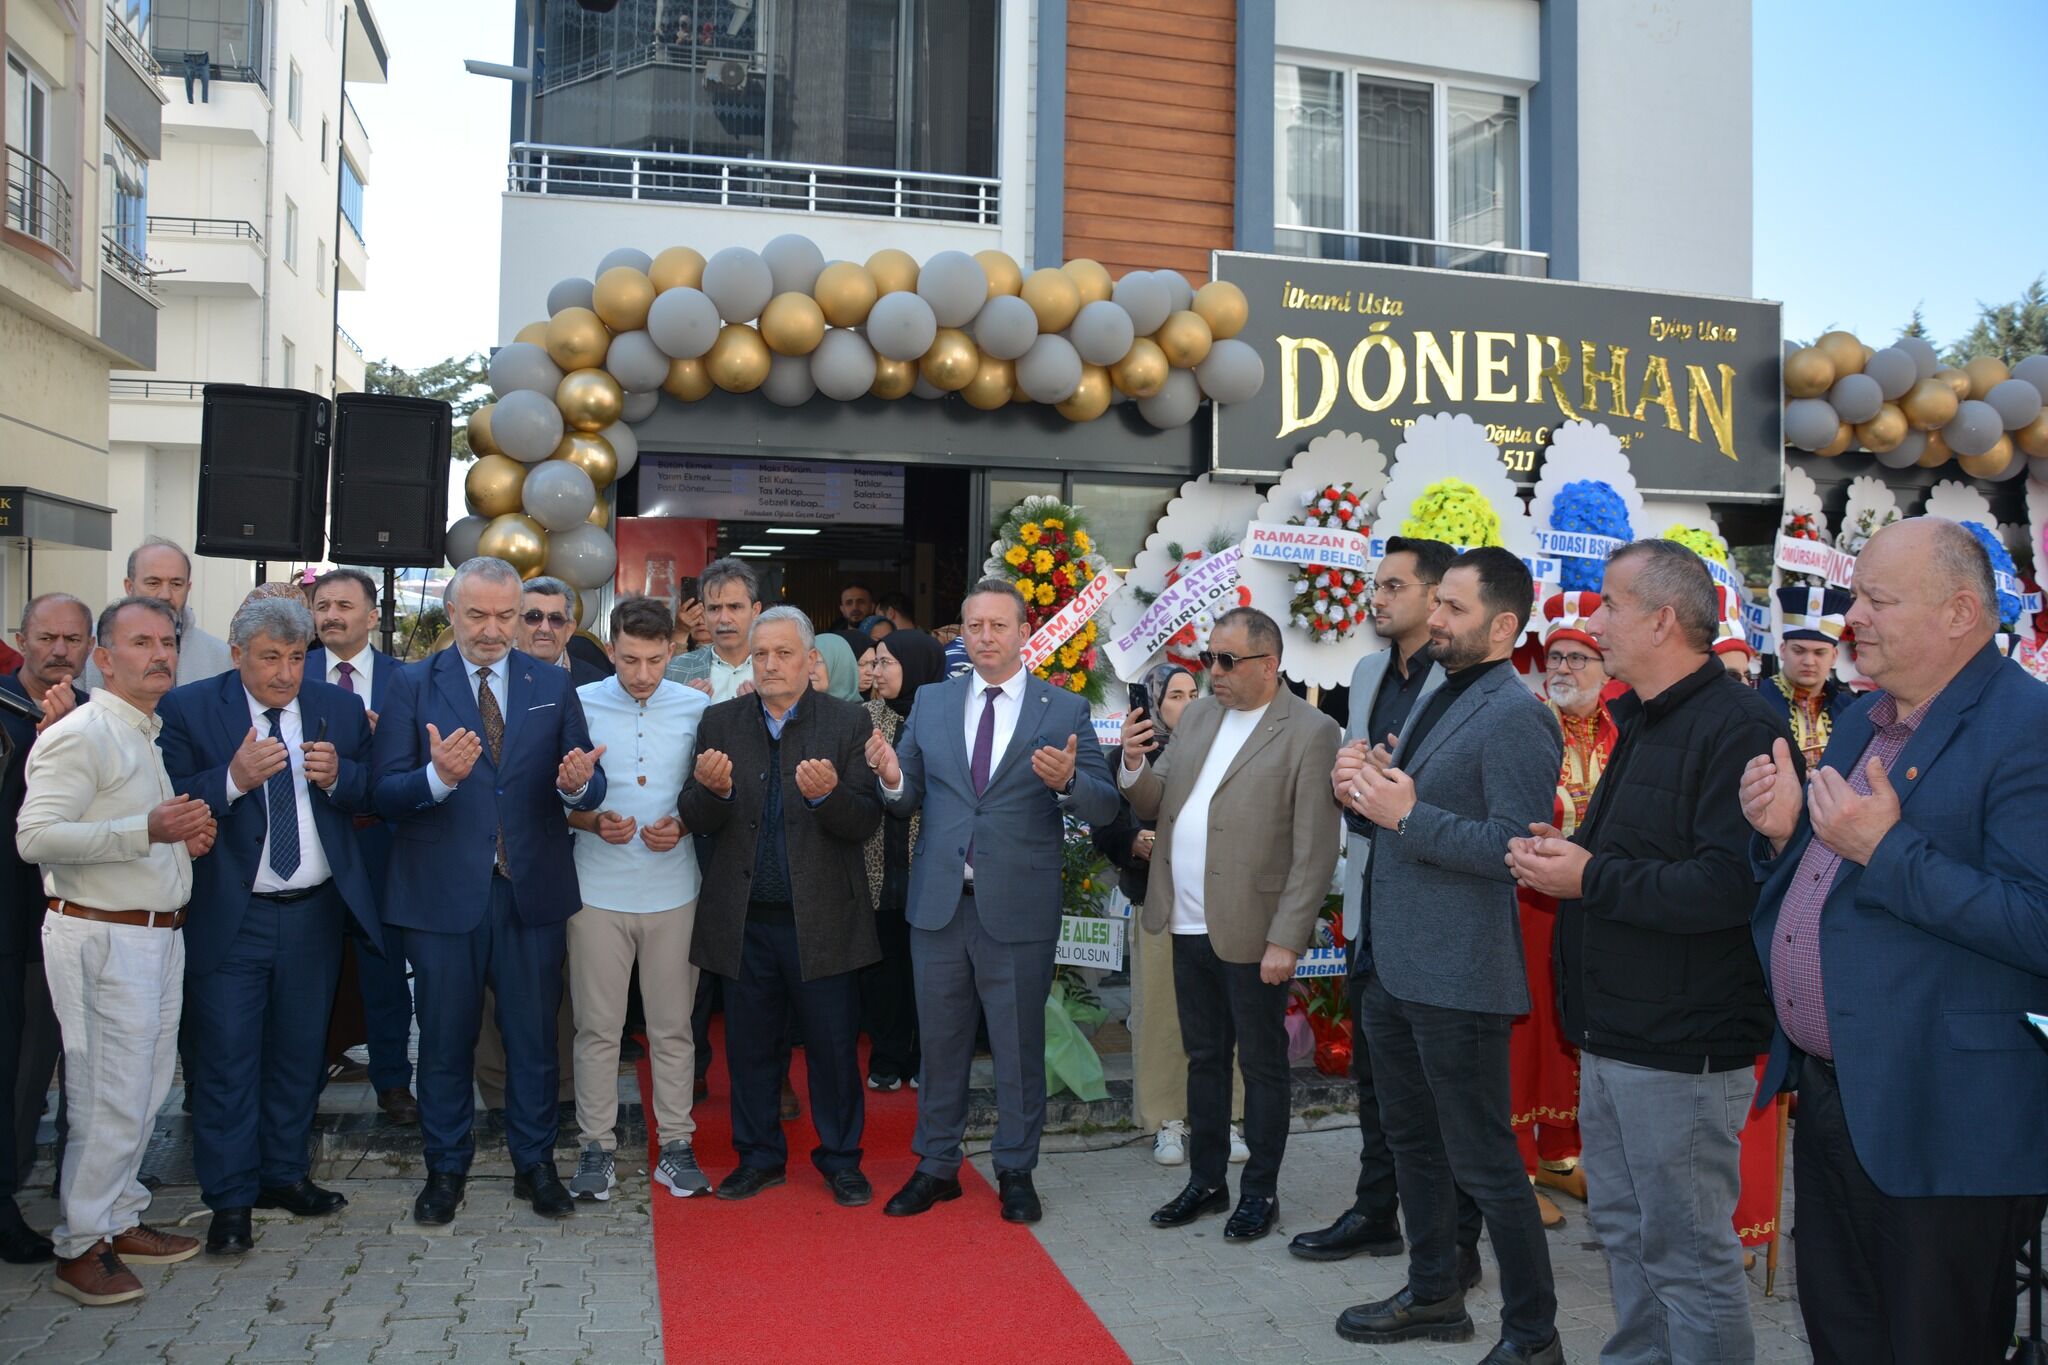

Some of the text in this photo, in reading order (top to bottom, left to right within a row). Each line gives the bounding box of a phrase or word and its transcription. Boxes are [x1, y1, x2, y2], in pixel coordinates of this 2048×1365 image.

[1357, 291, 1404, 316] Usta
[1698, 320, 1737, 342] Usta
[775, 487, 803, 497] Kebap
[790, 499, 818, 510] Kebap
[1253, 529, 1345, 549] RAMAZAN
[1550, 534, 1587, 554] ODASI
[1252, 544, 1315, 561] ALAÇAM
[1072, 575, 1108, 614] OTO
[1118, 589, 1180, 652] ERKAN
[1145, 612, 1173, 637] VE
[1146, 599, 1207, 653] HAYIRLI
[1073, 947, 1111, 963] OLSUN
[1296, 964, 1346, 977] ORGAN
